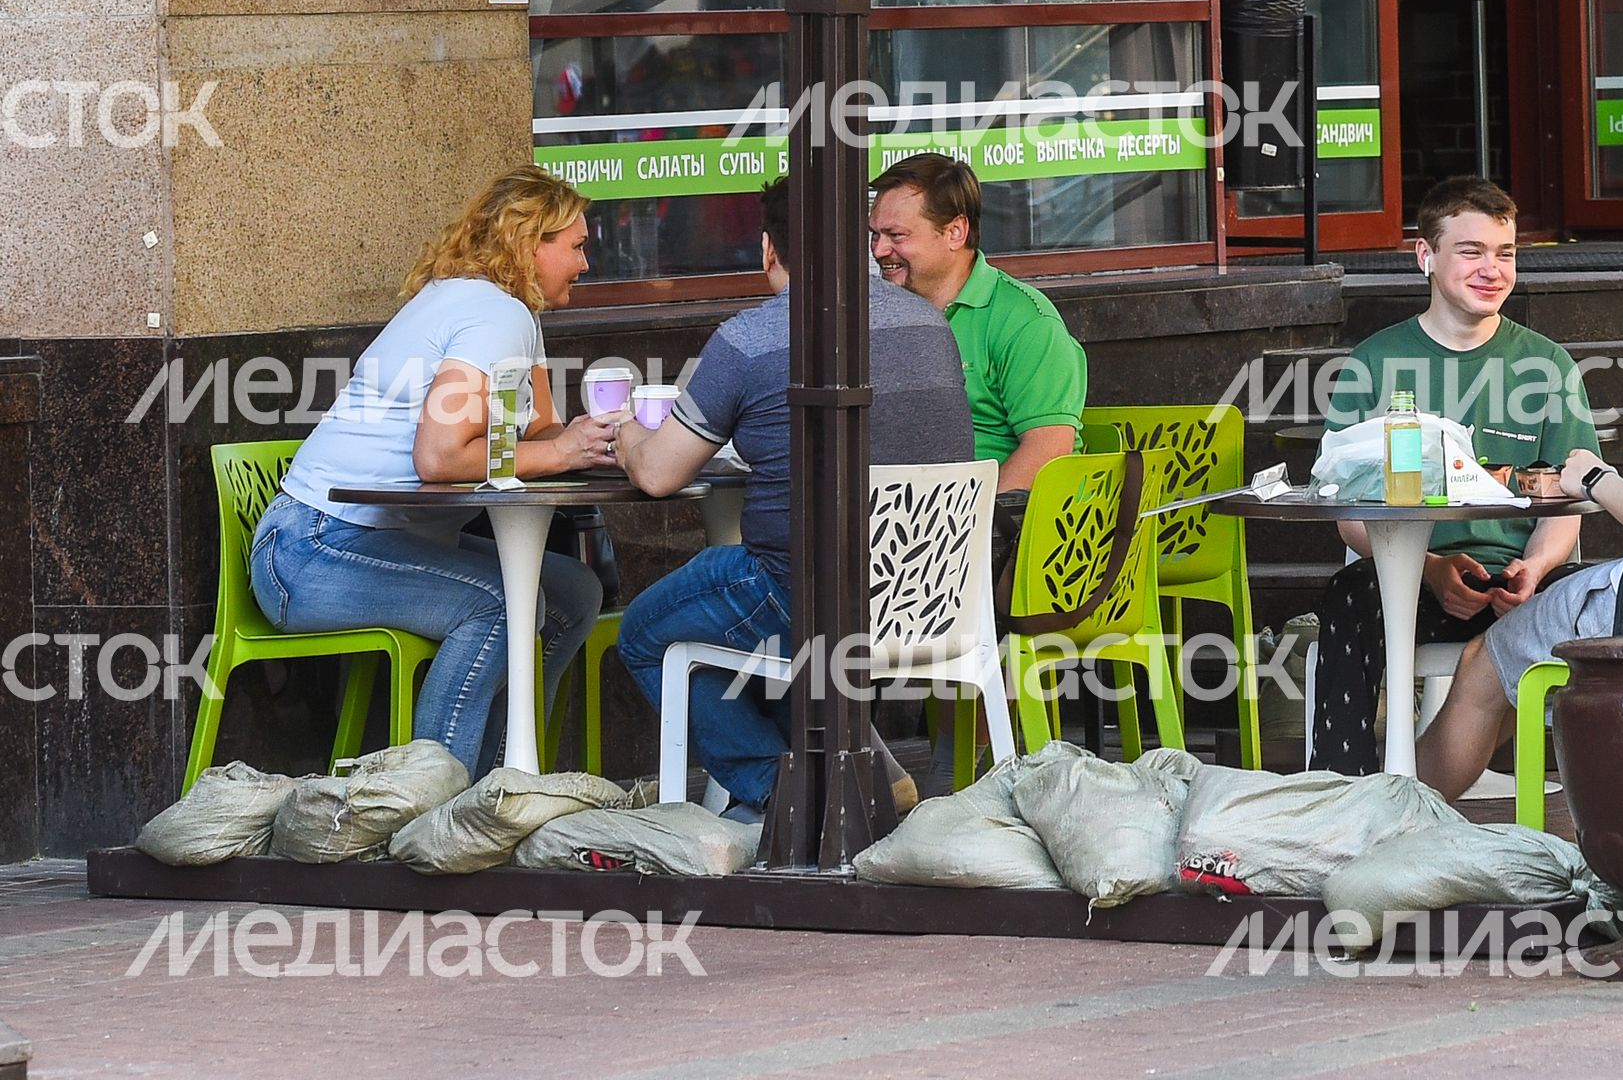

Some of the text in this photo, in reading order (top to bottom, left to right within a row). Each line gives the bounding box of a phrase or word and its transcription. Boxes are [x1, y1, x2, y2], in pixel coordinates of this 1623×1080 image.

[984, 142, 1024, 166] КОФЕ
[1037, 138, 1105, 163] ВЫПЕЧКА
[1117, 134, 1180, 161] ДЕСЕРТЫ
[534, 158, 623, 188] АНДВИЧИ
[637, 154, 705, 180] САЛАТЫ
[719, 151, 765, 176] СУПЫ
